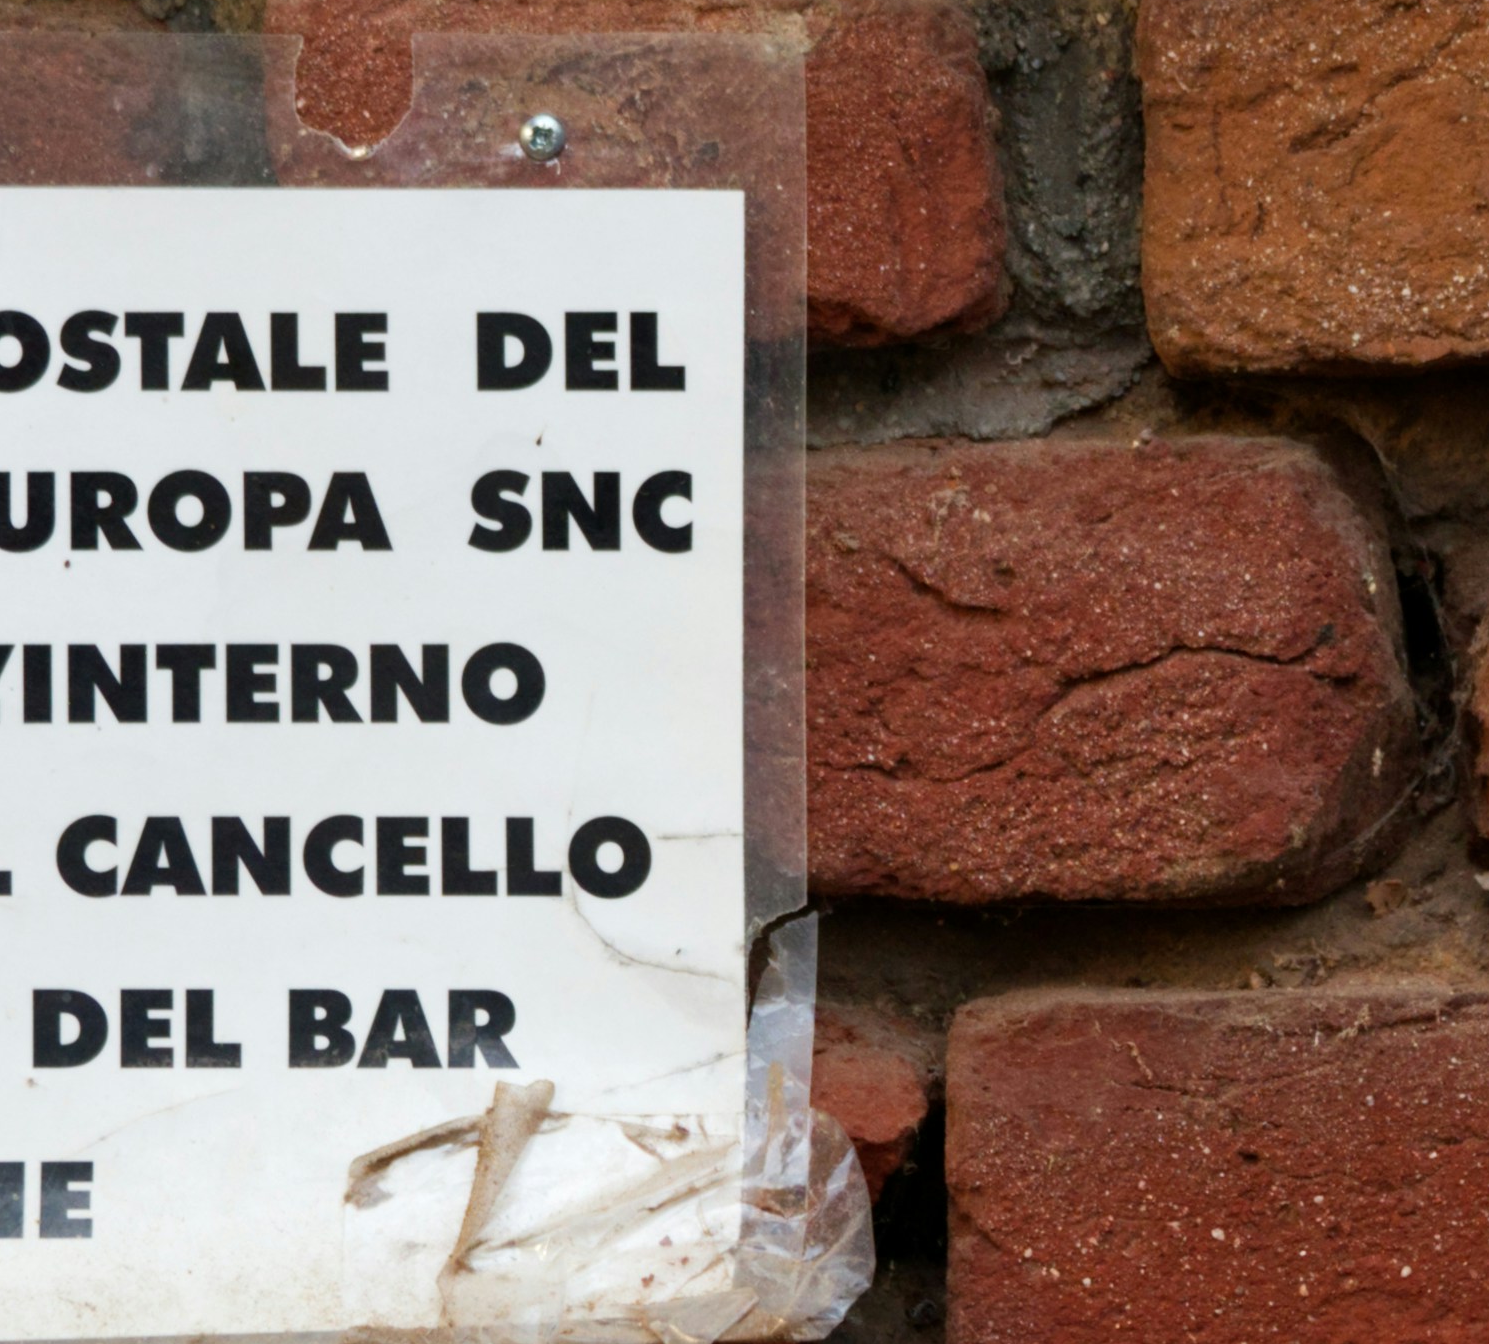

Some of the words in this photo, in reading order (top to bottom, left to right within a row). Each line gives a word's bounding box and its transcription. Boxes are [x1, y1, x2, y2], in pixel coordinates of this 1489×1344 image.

[476, 310, 686, 392] DEL
[467, 469, 693, 554] SNC
[55, 814, 652, 900] CANCELLO
[32, 988, 242, 1069] DEL
[288, 988, 518, 1070] BAR
